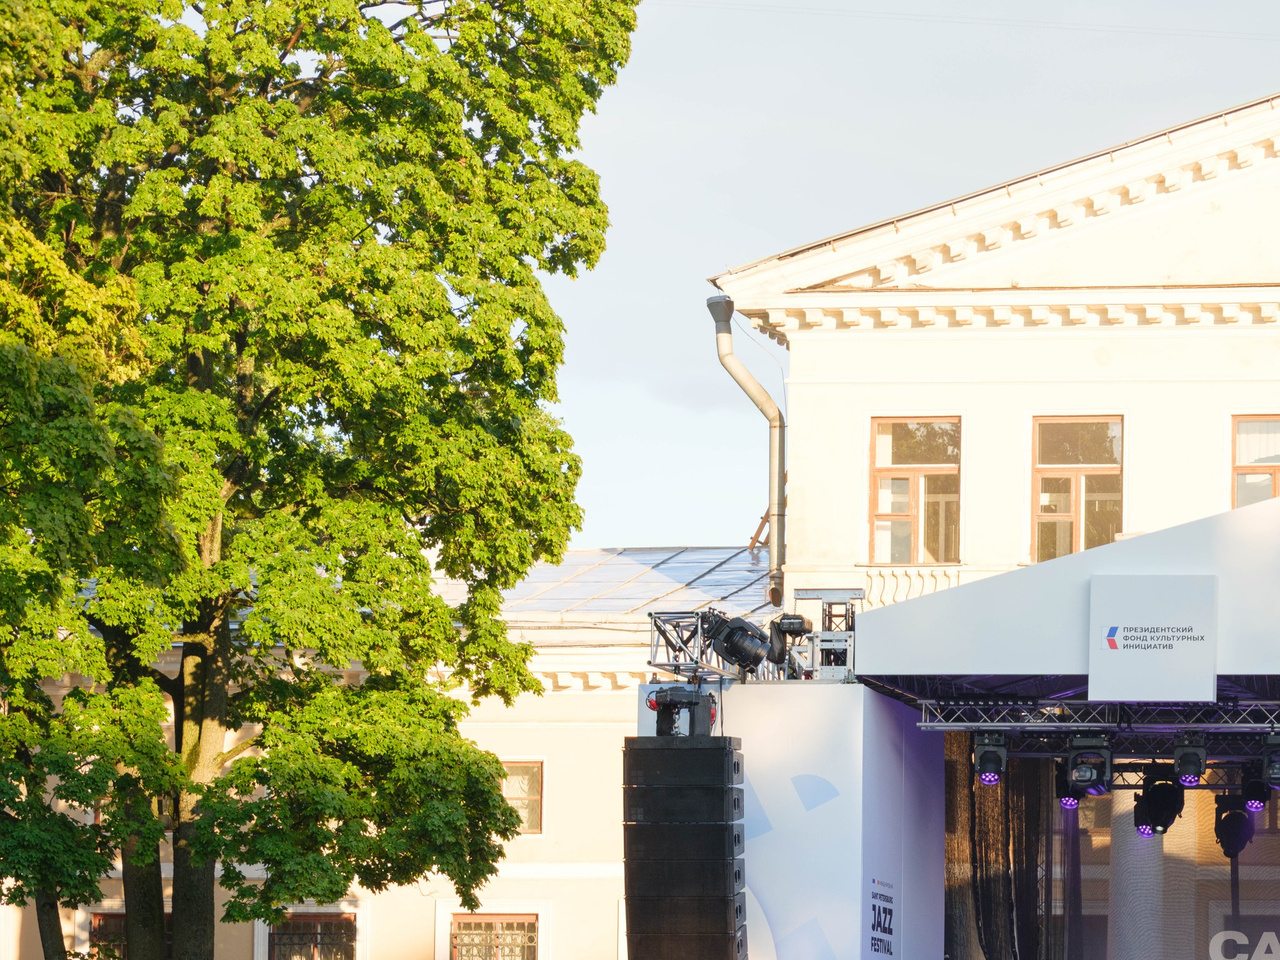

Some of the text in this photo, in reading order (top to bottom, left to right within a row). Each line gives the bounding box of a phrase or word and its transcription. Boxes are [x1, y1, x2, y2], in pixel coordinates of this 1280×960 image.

[1123, 626, 1194, 634] ПРЕЗИДЕНТСКИЙ
[871, 904, 893, 936] JAZZ
[870, 937, 893, 956] FESTIVAL
